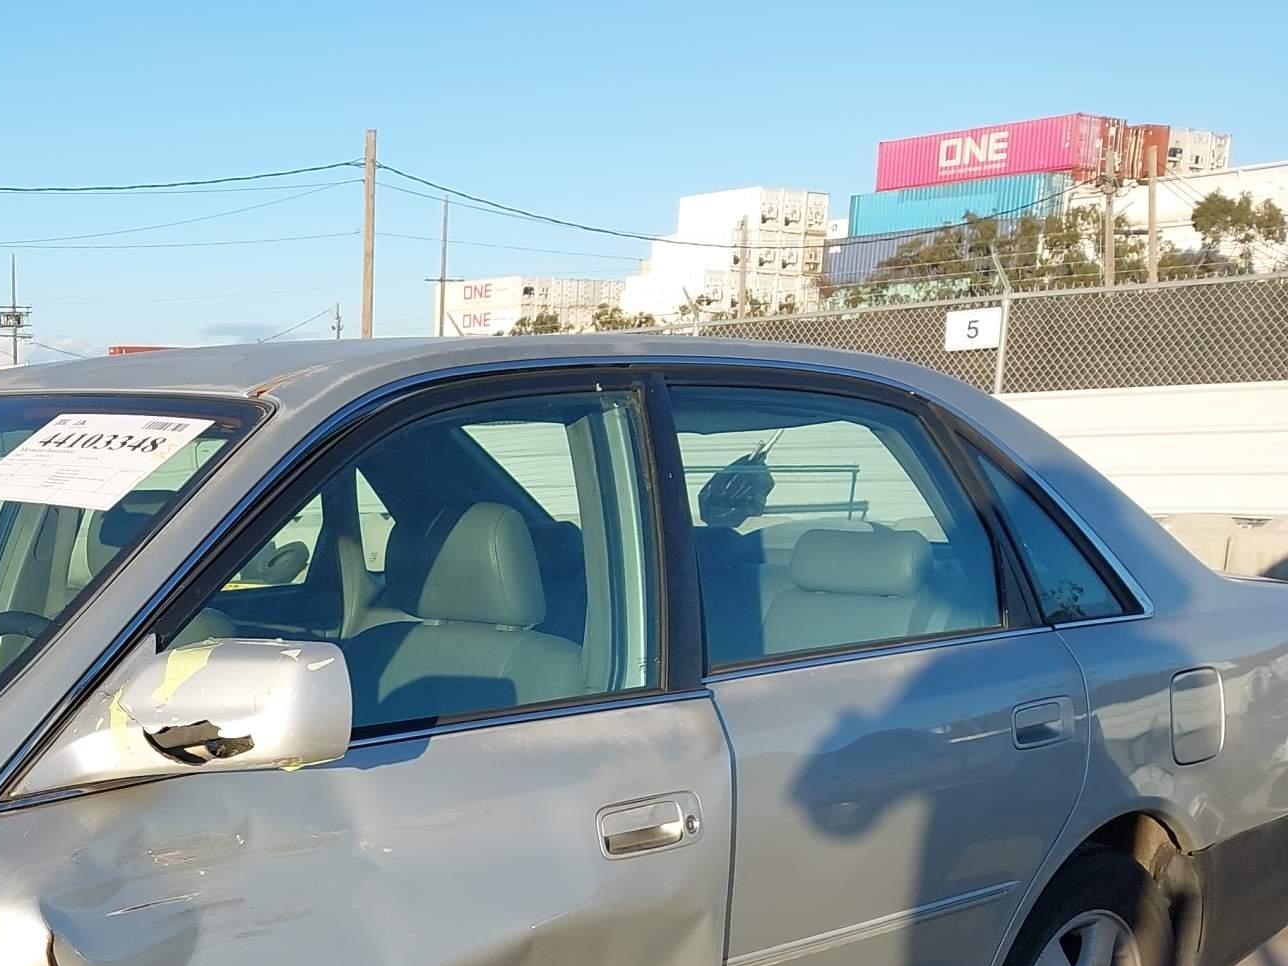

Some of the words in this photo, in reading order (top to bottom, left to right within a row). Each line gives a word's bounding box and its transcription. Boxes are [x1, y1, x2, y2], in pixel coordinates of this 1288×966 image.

[939, 131, 1009, 167] ONE
[463, 284, 492, 300] ONE
[462, 312, 491, 328] ONE
[966, 319, 980, 339] 5
[39, 432, 166, 453] 44103348
